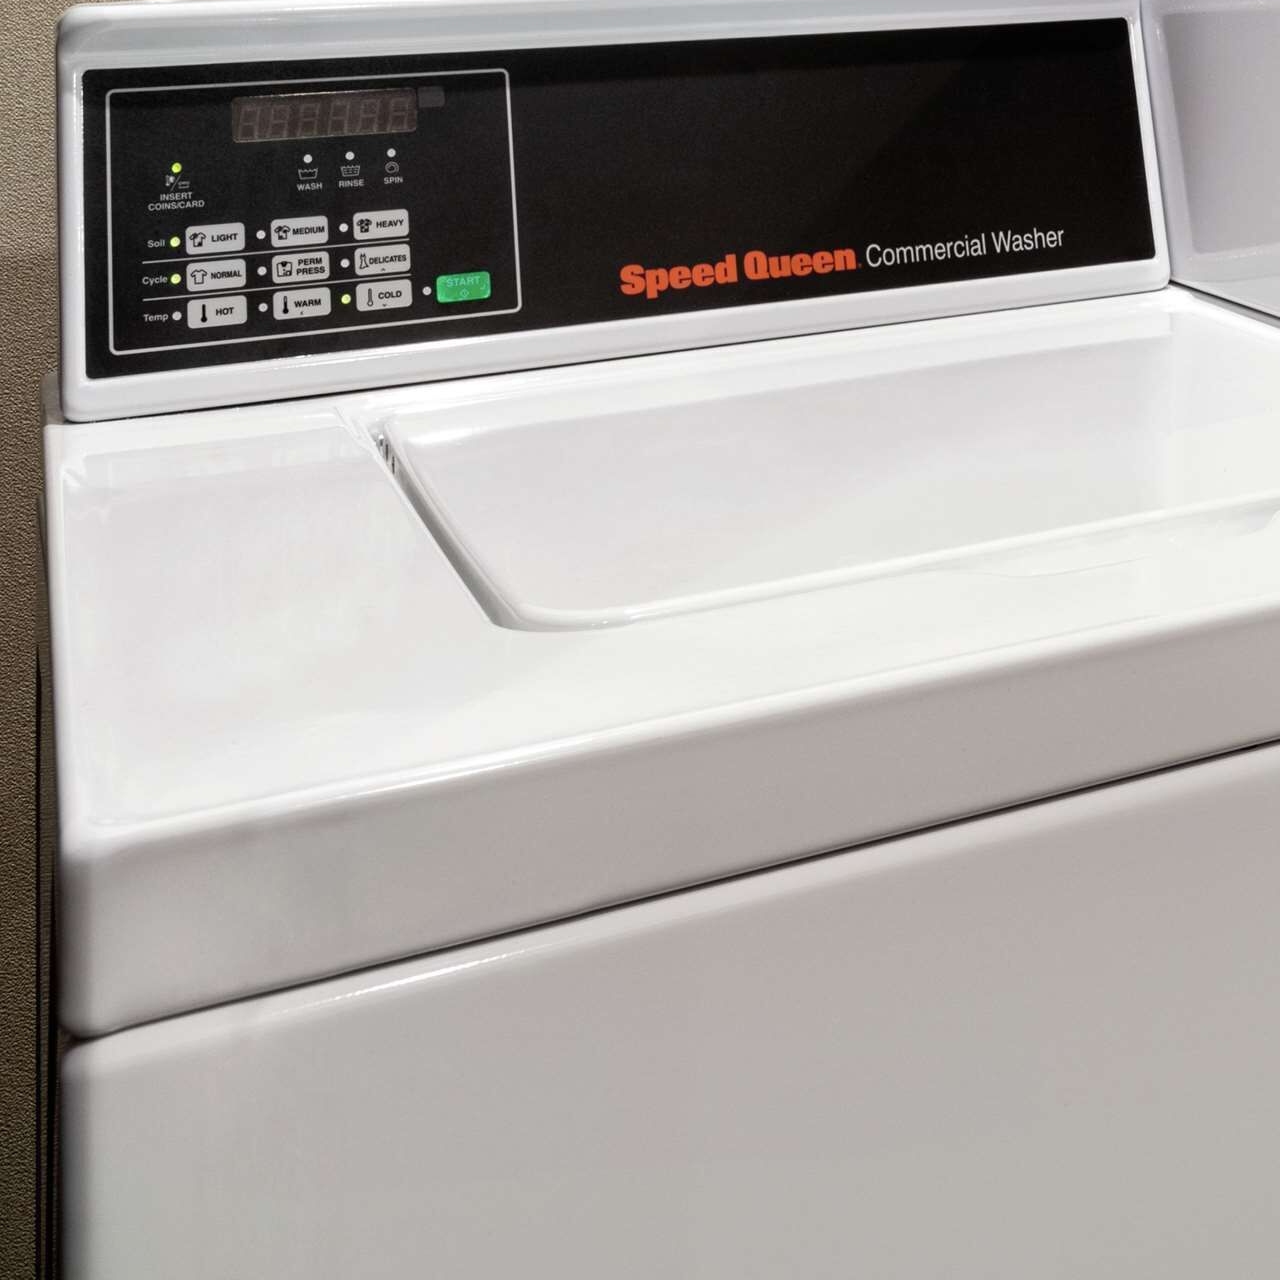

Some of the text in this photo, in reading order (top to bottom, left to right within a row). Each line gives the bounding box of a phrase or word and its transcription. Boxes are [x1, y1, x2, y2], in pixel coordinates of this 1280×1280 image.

[338, 179, 364, 188] RINSE
[383, 176, 403, 185] SPIN
[297, 182, 323, 191] WASH
[160, 192, 193, 201] INSERT
[147, 200, 205, 211] COINS/CARD
[376, 219, 404, 228] HEAVY
[292, 226, 325, 235] MEDIUM
[211, 233, 238, 243] LIGHT
[147, 239, 165, 248] Soil
[298, 257, 323, 266] PERM
[369, 254, 407, 265] DELICATES
[619, 226, 1065, 300] Speed Queen Commercial Washer
[211, 270, 242, 279] NORMAL
[296, 266, 325, 275] PRESS
[142, 275, 168, 286] Cycle
[446, 275, 480, 288] START
[378, 290, 402, 299] COLD
[294, 298, 321, 308] WARM
[215, 307, 234, 316] HOT
[143, 312, 168, 322] Temp
